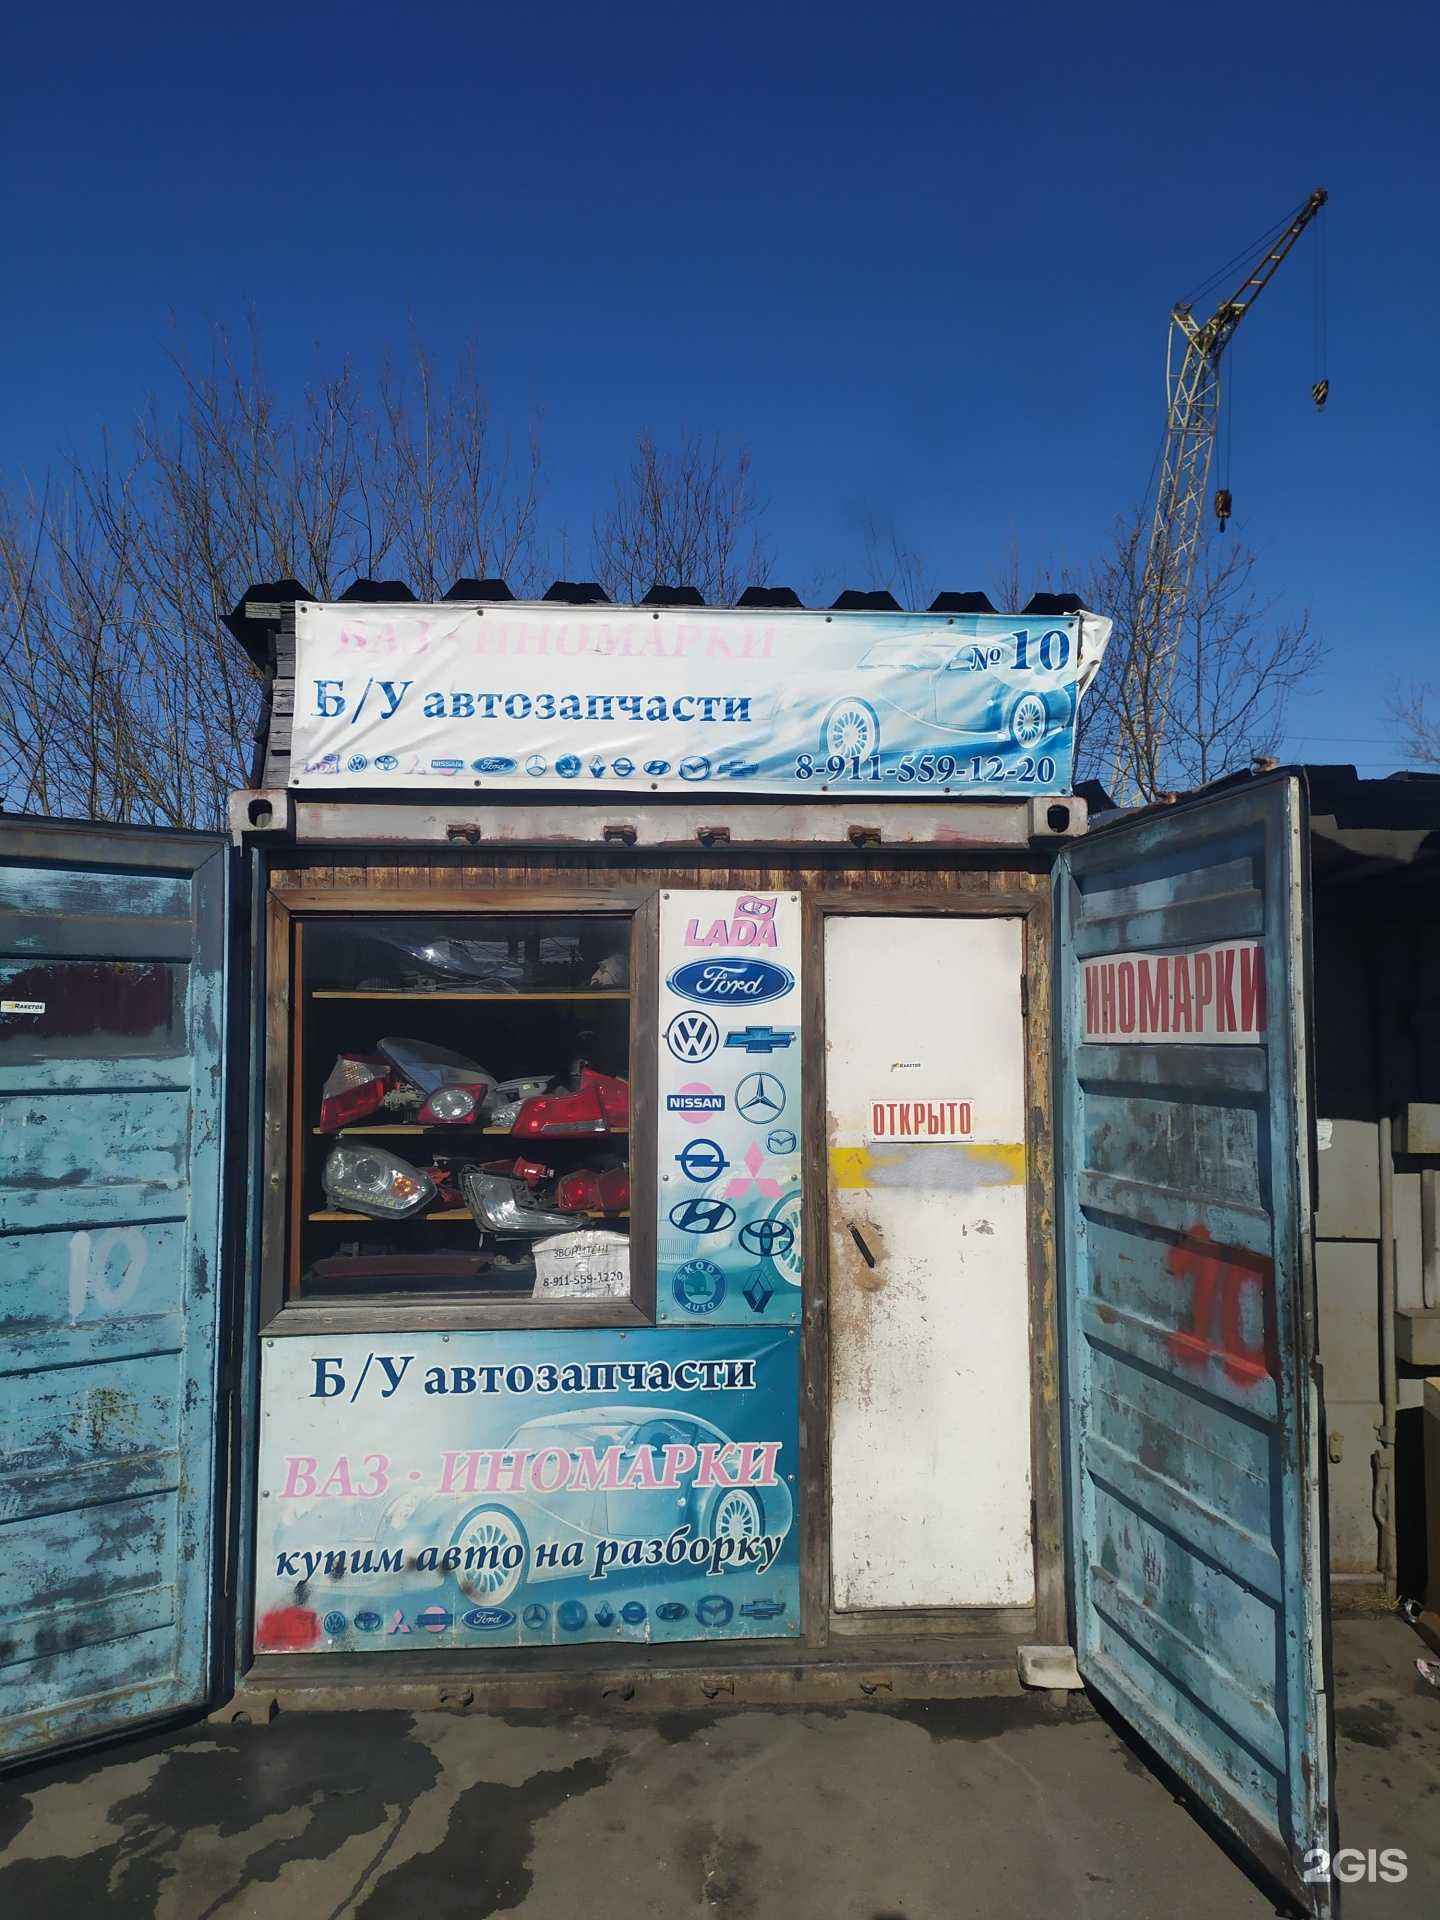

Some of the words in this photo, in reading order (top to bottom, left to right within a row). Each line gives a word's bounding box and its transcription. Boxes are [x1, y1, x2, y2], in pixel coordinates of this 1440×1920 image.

[473, 622, 779, 658] ИНОМАРКИ
[1011, 629, 1071, 672] 10
[310, 676, 414, 724] Б/У
[422, 690, 753, 723] автозапчасти
[793, 753, 1056, 784] 8-911-559-12-20
[683, 918, 778, 948] LADA
[696, 965, 764, 996] Ford
[1085, 946, 1267, 1035] ИНОМАРКИ
[669, 1097, 723, 1109] NISSAN
[873, 1103, 972, 1136] ОТКРЫТО
[68, 1228, 149, 1327] 10
[1167, 1223, 1272, 1389] 10
[309, 1352, 416, 1403] Б/У
[423, 1358, 757, 1396] автозапчасти
[279, 1453, 391, 1499] ВАЗ
[438, 1441, 783, 1495] ИНОМАРКИ
[276, 1546, 404, 1586] купим
[416, 1544, 524, 1573] авто
[535, 1538, 585, 1568] на
[590, 1525, 783, 1580] разборку
